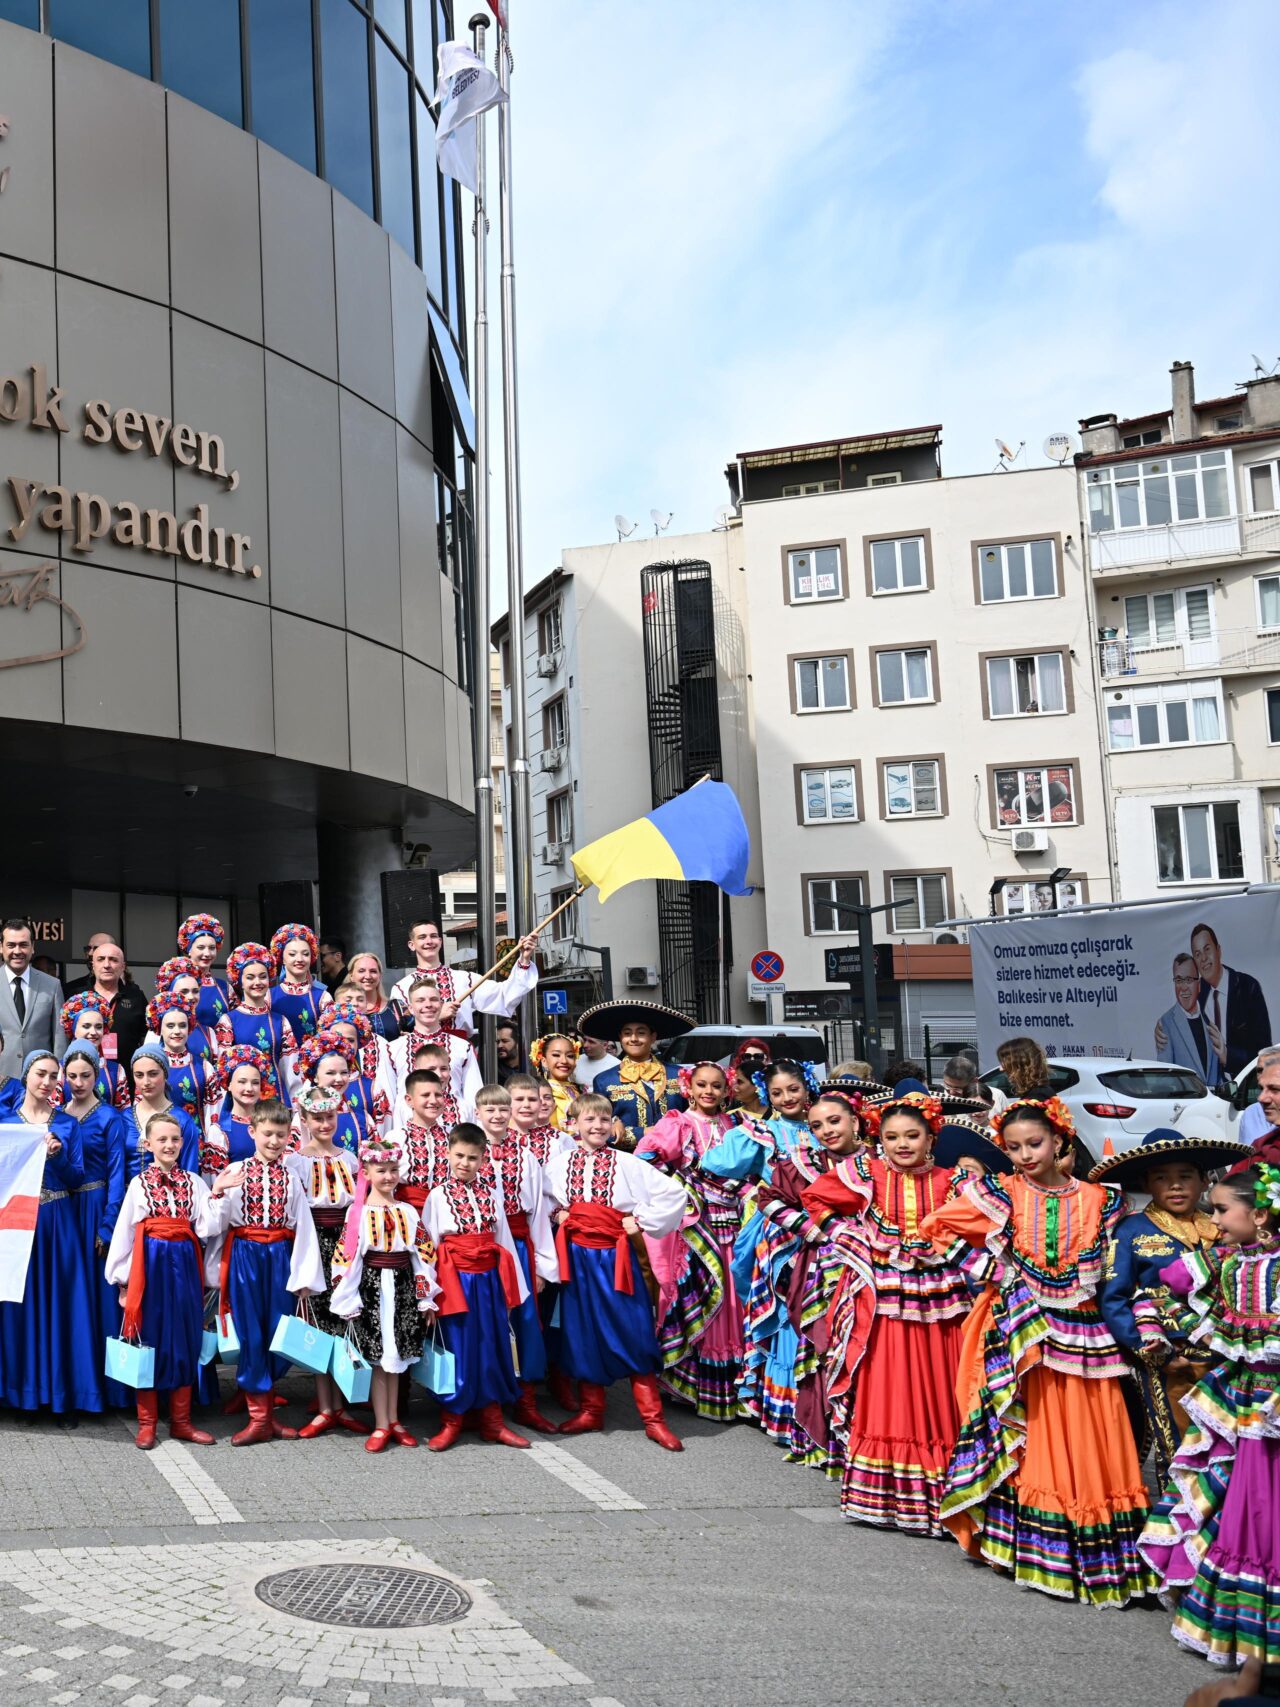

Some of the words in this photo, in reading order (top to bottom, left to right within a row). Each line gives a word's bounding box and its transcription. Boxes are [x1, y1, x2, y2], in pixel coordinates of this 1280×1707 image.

[84, 399, 241, 490] seven,
[6, 475, 263, 580] yapandır.
[993, 945, 1026, 958] Omuz
[1028, 943, 1068, 956] omuza
[1070, 934, 1133, 959] çalışarak
[996, 966, 1031, 981] sizlere
[1033, 964, 1075, 980] hizmet
[1077, 959, 1140, 981] edeceğiz.
[546, 993, 559, 1010] P
[997, 988, 1047, 1004] Balıkesir
[1049, 991, 1063, 1003] ve
[1065, 986, 1118, 1007] Altıeylül
[999, 1011, 1022, 1027] bize
[1024, 1013, 1074, 1027] emanet.
[1062, 1045, 1085, 1054] HAKAN
